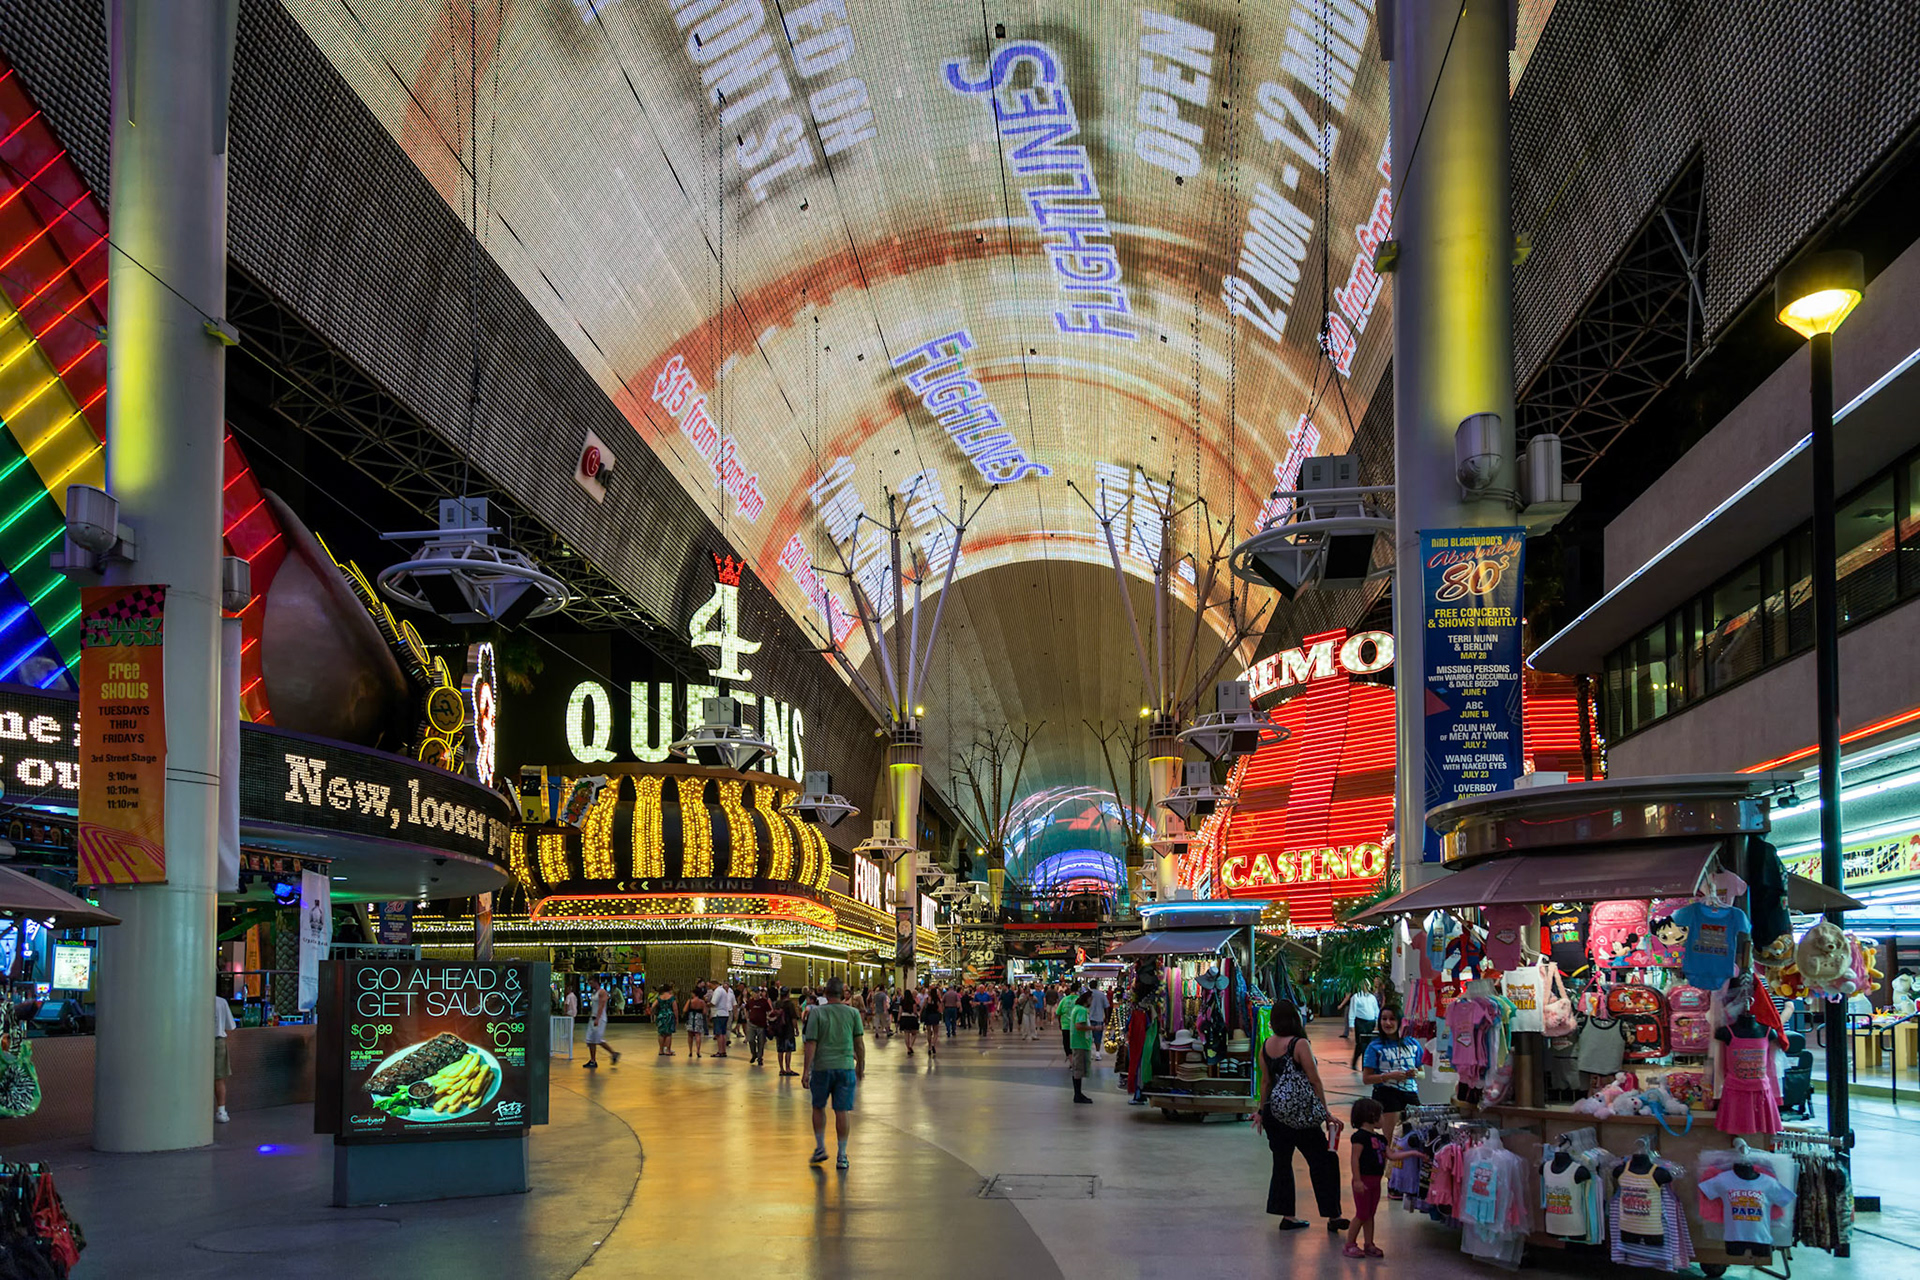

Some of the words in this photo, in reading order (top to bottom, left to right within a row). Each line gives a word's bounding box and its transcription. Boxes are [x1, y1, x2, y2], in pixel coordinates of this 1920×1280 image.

[1134, 8, 1216, 178] OPEN
[1254, 79, 1342, 176] 12
[1237, 183, 1316, 308] NOON
[1221, 273, 1289, 344] 12
[651, 353, 698, 418] $15
[678, 389, 720, 462] from
[1427, 537, 1522, 568] Absolutely
[1435, 608, 1458, 618] FREE
[1460, 606, 1511, 618] CONCERTS
[1428, 618, 1436, 628] &
[1437, 618, 1475, 628] SHOWS
[1477, 616, 1518, 627] NIGHTLY
[688, 581, 762, 682] 4
[1448, 635, 1472, 644] TERRI
[1473, 634, 1499, 643] NUNN
[1454, 643, 1462, 652] &
[1463, 642, 1493, 651] BERLIN
[1460, 651, 1475, 660] MAY
[1476, 651, 1487, 660] 28
[1436, 665, 1472, 674] MISSING
[1473, 664, 1510, 674] PERSONS
[1445, 674, 1474, 682] WARREN
[1456, 680, 1474, 688] DALE
[1461, 687, 1480, 696] JUNE
[1481, 687, 1487, 696] 4
[98, 705, 150, 717] TUESDAYS
[1465, 701, 1484, 710] ABC
[1459, 711, 1478, 719] JUNE
[1480, 710, 1489, 718] 18
[110, 719, 137, 730] THRU
[1452, 723, 1476, 733] COLIN
[1478, 723, 1496, 732] HAY
[102, 733, 145, 744] FRIDAYS
[1449, 732, 1469, 741] MEN
[1471, 732, 1482, 741] AT
[1483, 731, 1509, 740] WORK
[1463, 741, 1480, 749] JULY
[1481, 740, 1487, 749] 2
[91, 753, 104, 763] 3rd
[105, 753, 129, 764] Street
[131, 753, 157, 765] Stage
[1445, 754, 1473, 763] WANG
[1475, 754, 1504, 763] CHUNG
[1443, 763, 1460, 771] WITH
[1462, 762, 1487, 770] NAKED
[1488, 761, 1507, 770] EYES
[1461, 771, 1478, 780] JULY
[1480, 770, 1489, 779] 23
[1453, 783, 1497, 793] LOVERBOY
[285, 753, 400, 830] New,
[407, 778, 486, 841] looser
[1221, 842, 1386, 890] CASINO
[854, 852, 881, 911] FOUR
[966, 930, 985, 941] $15
[970, 950, 995, 962] $50
[357, 967, 401, 991] GO
[408, 968, 497, 990] AHEAD
[504, 968, 522, 991] &
[357, 992, 418, 1017] GET
[426, 991, 523, 1017] SAUCY
[1731, 1207, 1763, 1216] PAPA
